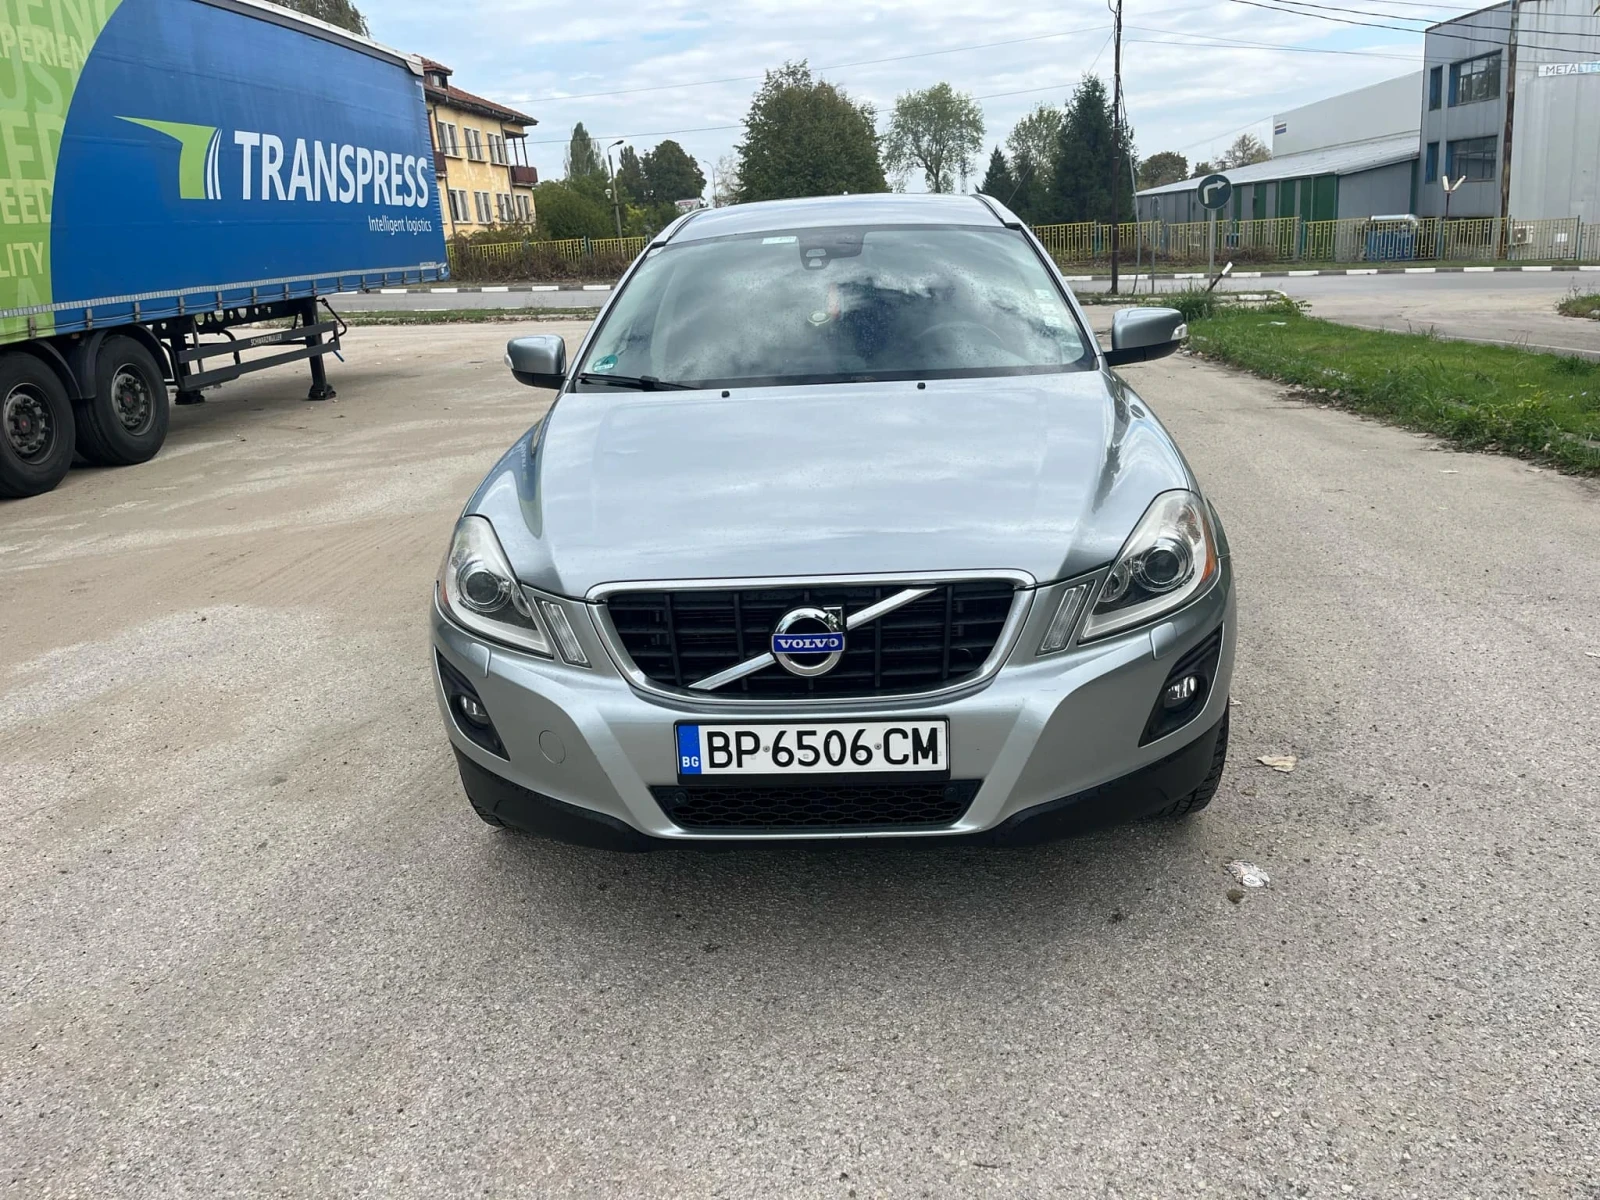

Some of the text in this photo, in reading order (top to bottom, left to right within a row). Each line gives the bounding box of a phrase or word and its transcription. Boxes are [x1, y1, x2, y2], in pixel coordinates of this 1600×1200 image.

[234, 130, 428, 208] TRANSPRESS
[368, 215, 432, 235] Intelligent logistics
[777, 636, 840, 650] VOLVO
[682, 755, 700, 768] BG
